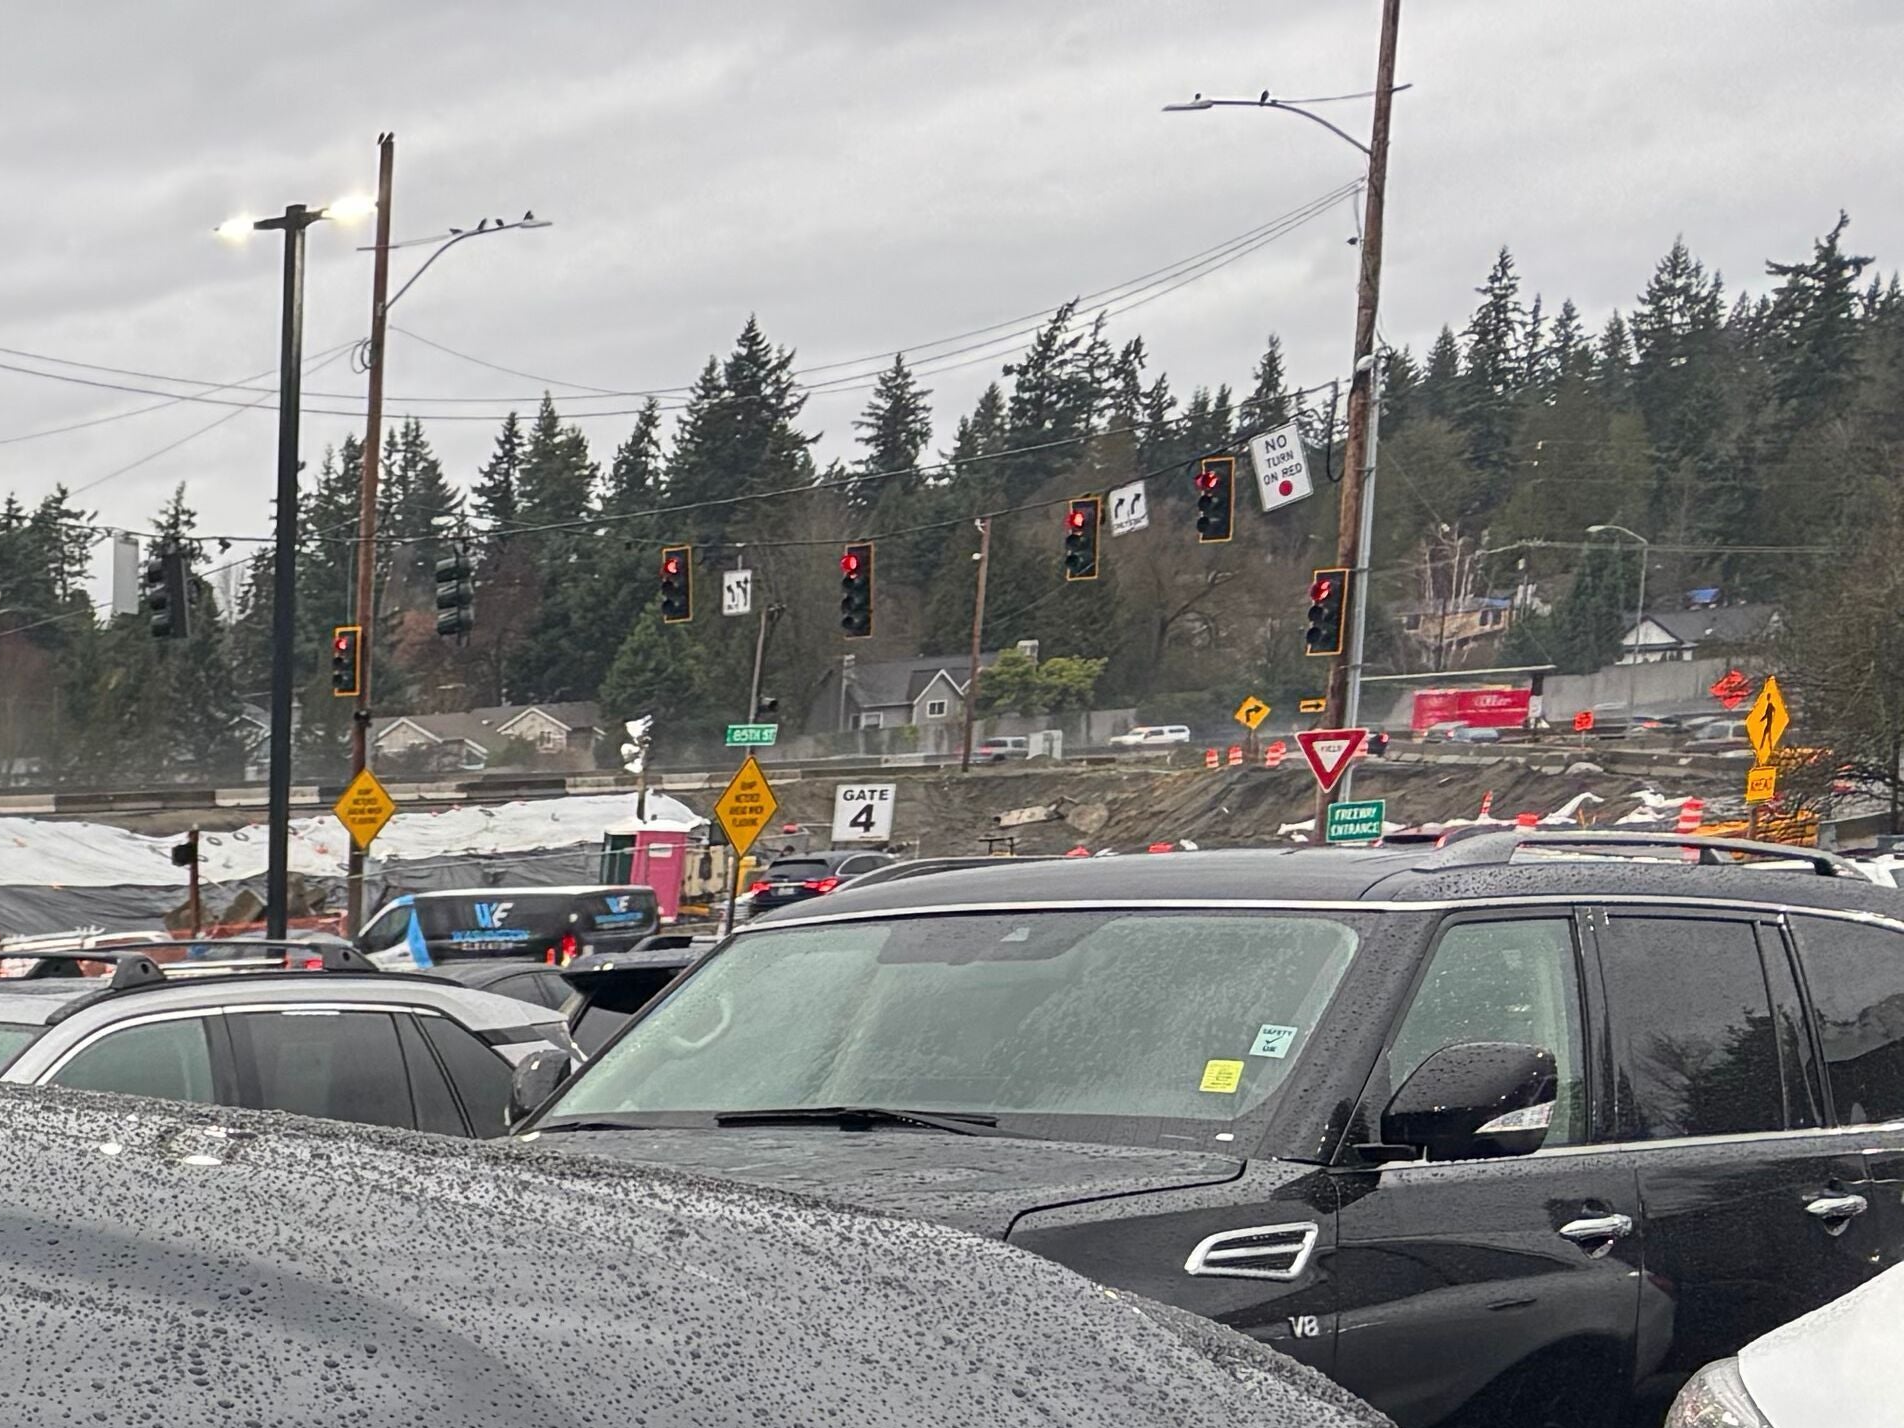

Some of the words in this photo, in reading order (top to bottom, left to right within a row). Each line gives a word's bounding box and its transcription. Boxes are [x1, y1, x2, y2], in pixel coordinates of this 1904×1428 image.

[1265, 434, 1287, 454] NO
[1266, 450, 1294, 468] TURN
[1263, 472, 1278, 485] ON
[1282, 462, 1303, 478] RED
[843, 789, 889, 801] GATE
[849, 804, 875, 833] 4
[1335, 807, 1378, 821] FREEWAY
[1330, 822, 1380, 836] ENTRANCE
[1288, 1315, 1320, 1338] V8
